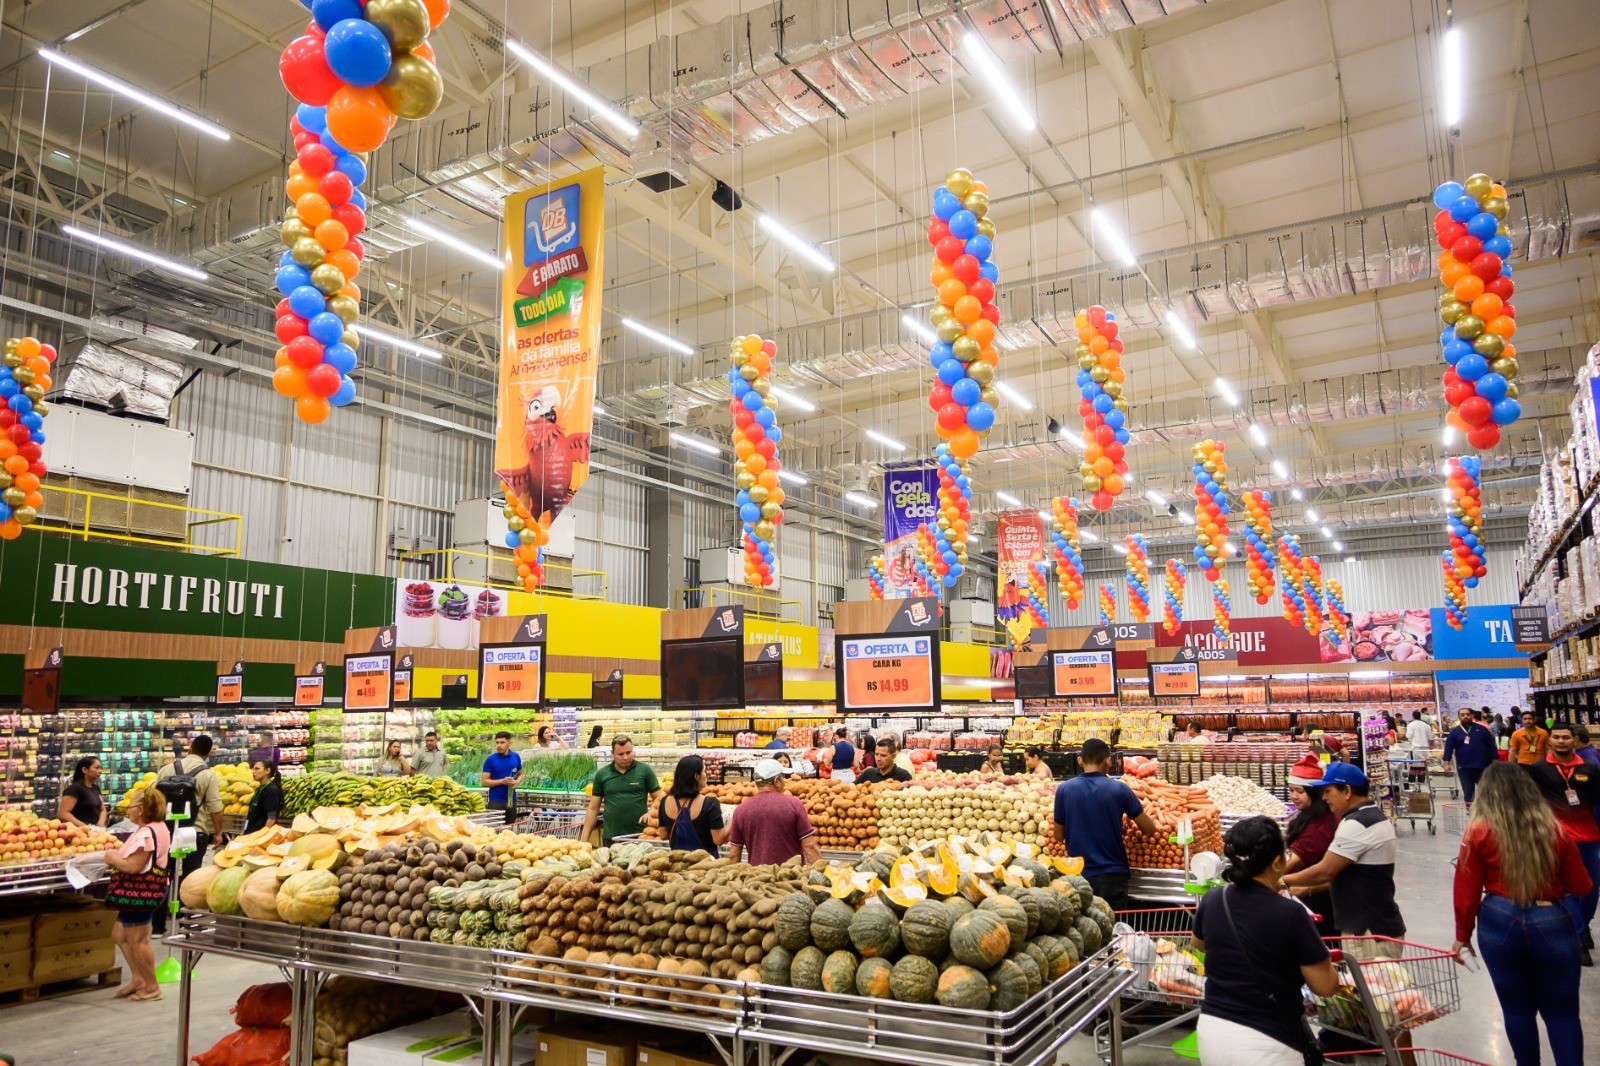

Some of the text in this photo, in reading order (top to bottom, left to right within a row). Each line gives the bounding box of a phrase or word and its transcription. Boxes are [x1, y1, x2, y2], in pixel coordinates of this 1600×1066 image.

[540, 253, 579, 283] BARATO
[520, 290, 566, 322] TODO DIA
[517, 329, 580, 350] as ofertas
[520, 340, 580, 364] da família
[510, 347, 592, 378] Amazonense!
[890, 480, 923, 495] Con
[895, 489, 931, 508] gela
[905, 503, 935, 519] dos
[1005, 526, 1038, 535] Quinta,
[1005, 534, 1031, 543] Sexta
[51, 562, 285, 619] HORTIFRUTI
[1484, 620, 1514, 643] TA
[865, 643, 909, 655] OFERTA
[497, 652, 526, 661] OFERTA
[873, 659, 901, 668] CARA KG
[1068, 655, 1098, 663] OFERTA
[357, 661, 380, 670] OFERTA
[497, 681, 521, 692] R$ 8,99
[867, 679, 909, 693] R$ 14,99
[1078, 677, 1095, 686] 3,99
